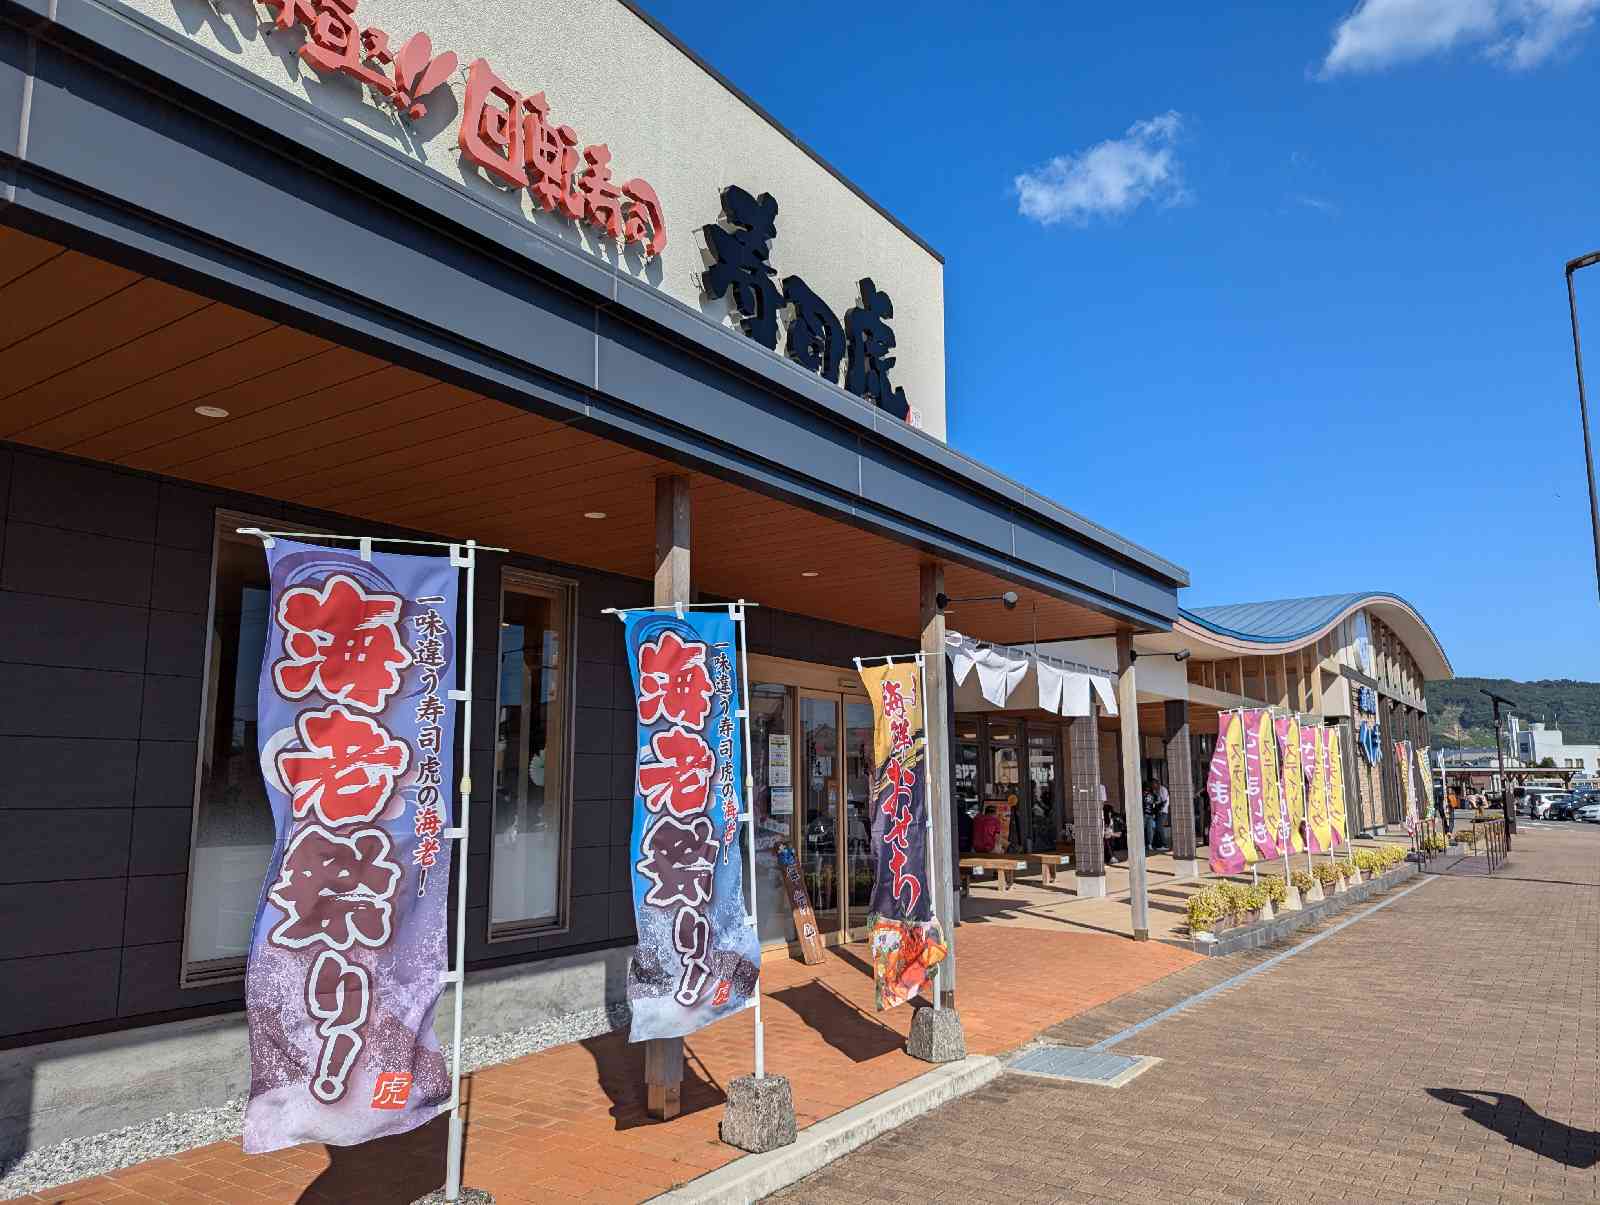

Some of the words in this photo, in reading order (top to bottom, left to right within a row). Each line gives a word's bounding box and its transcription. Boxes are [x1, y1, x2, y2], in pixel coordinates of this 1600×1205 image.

[701, 184, 910, 421] 寿司虎
[268, 573, 414, 1104] 海老祭り!
[635, 630, 721, 1007] 海老祭り!
[373, 1074, 410, 1106] 虎
